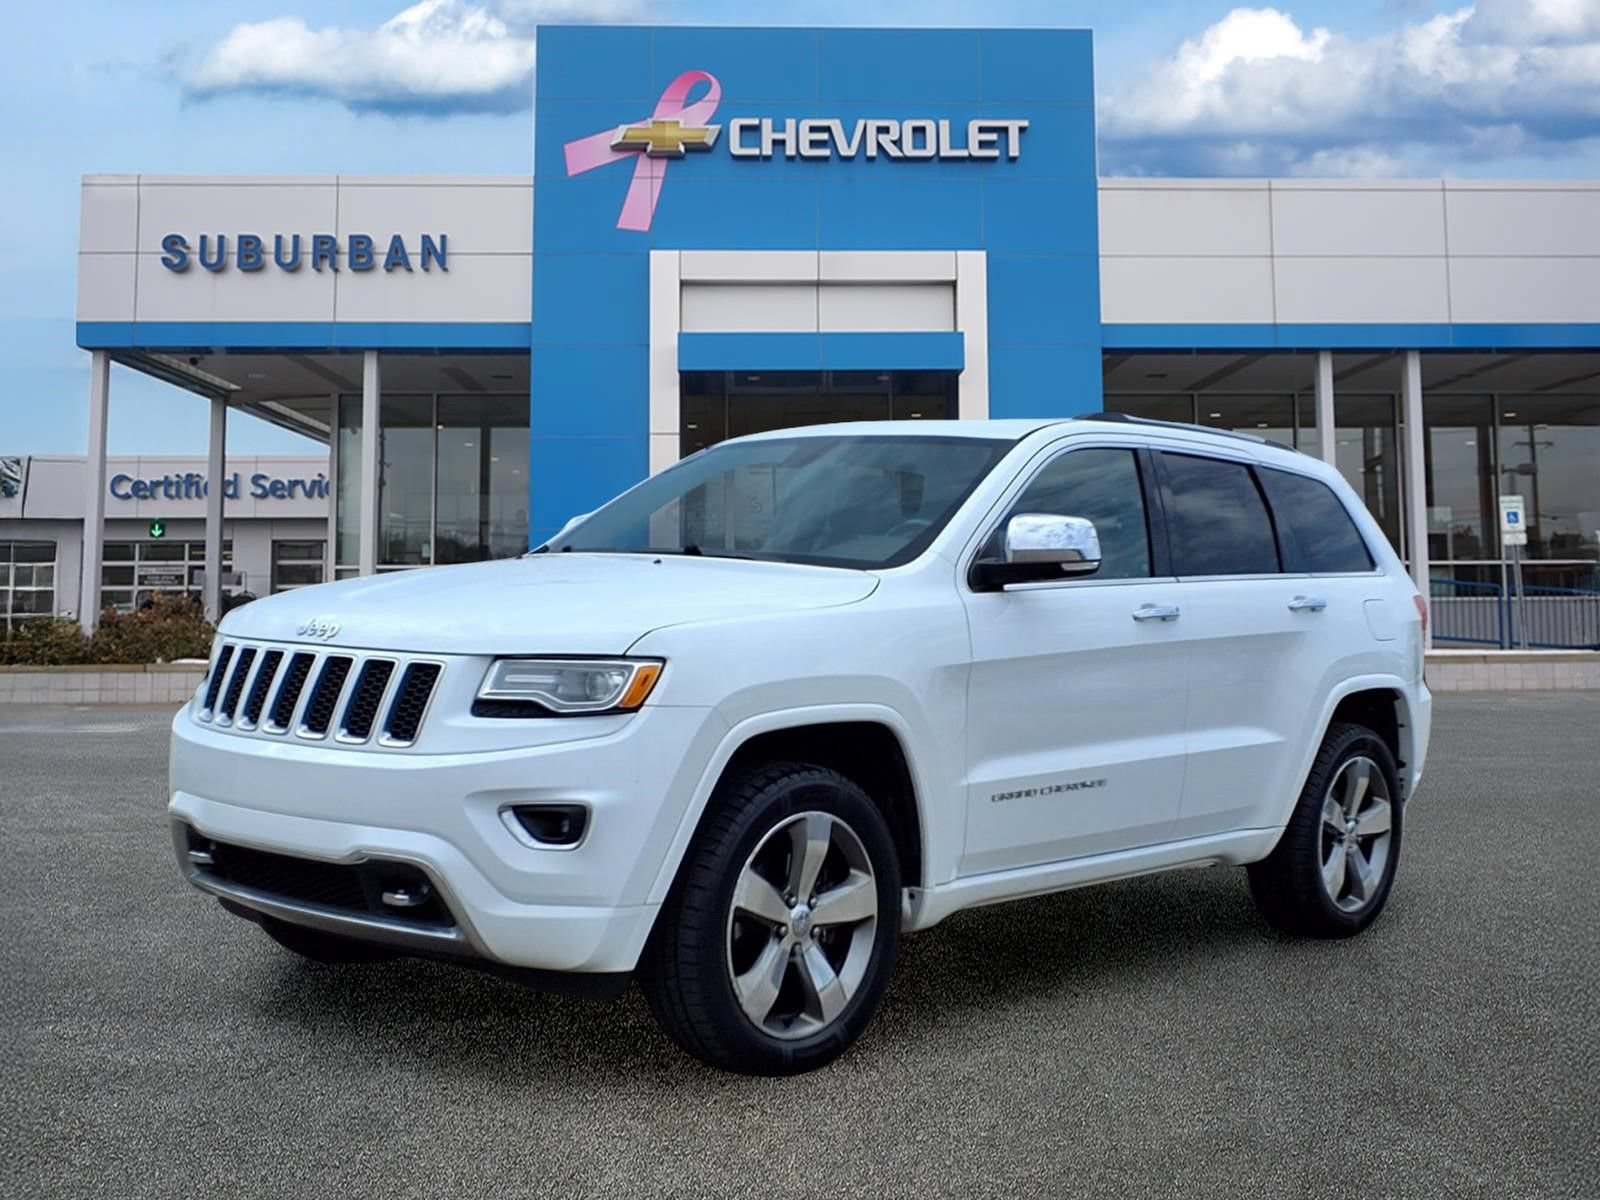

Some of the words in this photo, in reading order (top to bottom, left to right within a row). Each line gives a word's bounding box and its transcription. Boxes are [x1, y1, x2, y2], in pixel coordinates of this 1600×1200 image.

[729, 117, 1030, 159] CHEVROLET
[160, 232, 449, 273] SUBURBAN
[297, 616, 342, 642] Jeep
[990, 787, 1038, 803] GRAND
[1040, 778, 1108, 796] CHEROKEE
